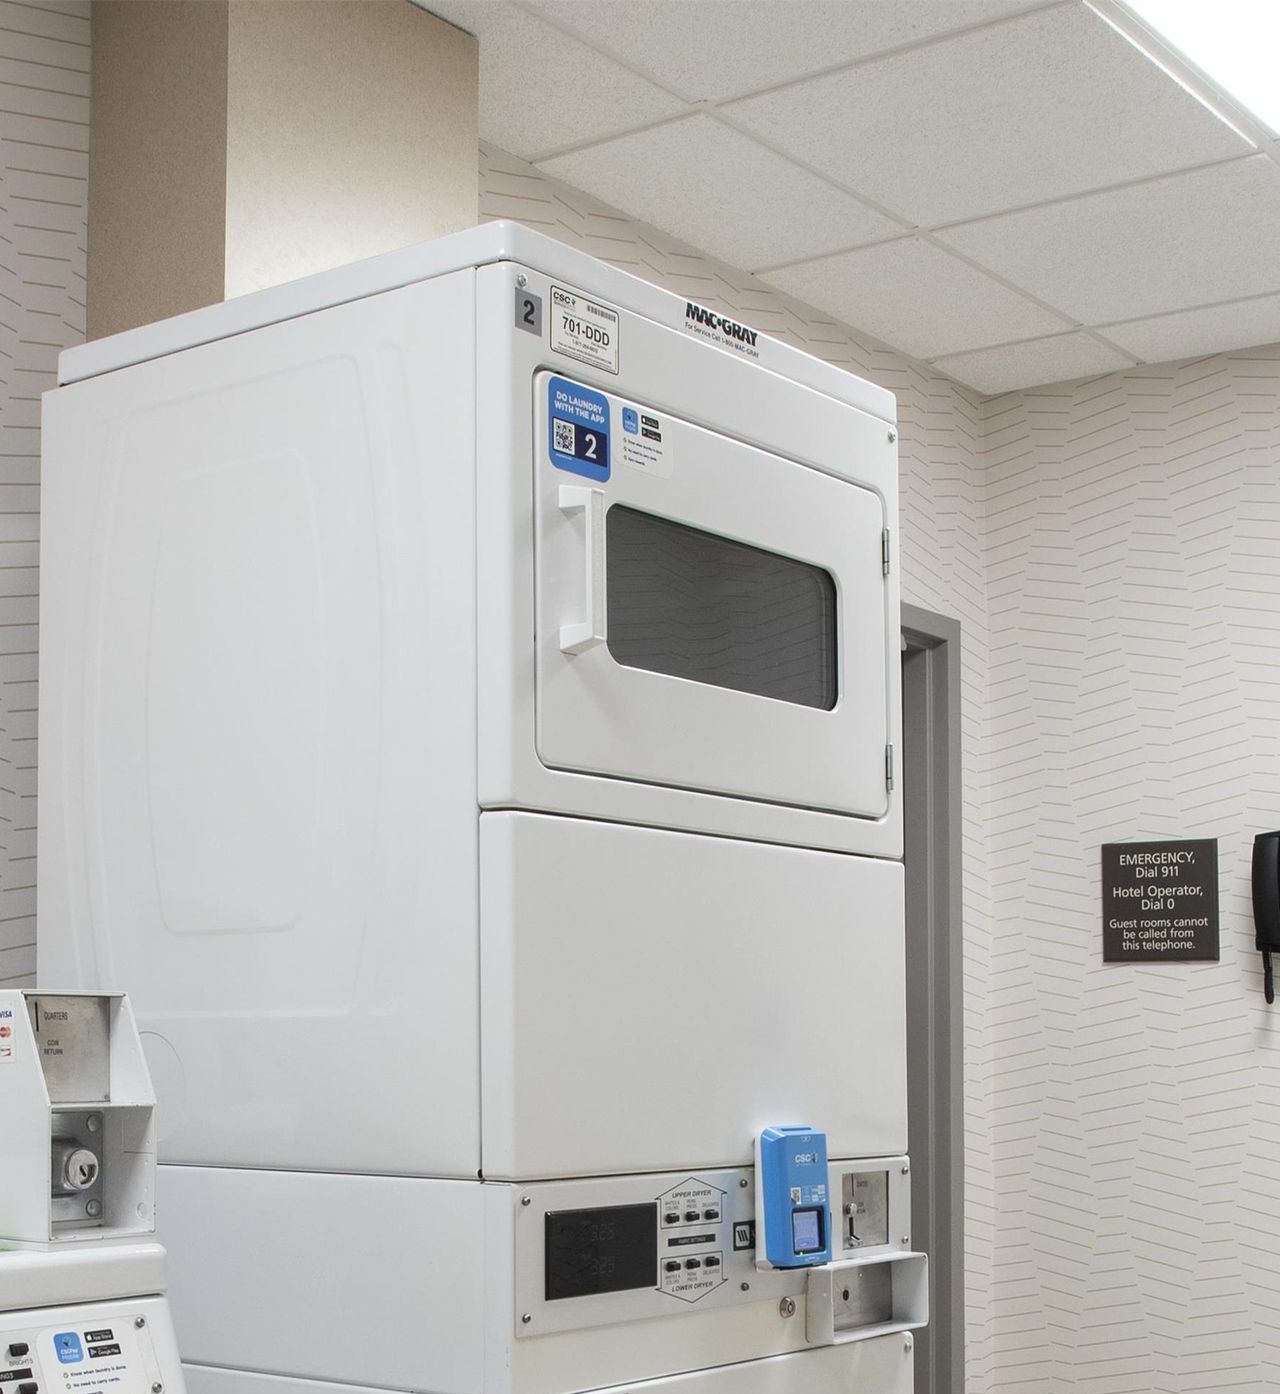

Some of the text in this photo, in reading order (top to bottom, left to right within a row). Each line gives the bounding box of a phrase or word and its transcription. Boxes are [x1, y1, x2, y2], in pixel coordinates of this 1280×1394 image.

[553, 291, 571, 305] CSC
[523, 299, 535, 326] 2
[562, 316, 610, 346] 701-DDD
[685, 321, 693, 330] For
[694, 325, 711, 339] Service
[556, 391, 603, 414] DO LAUNDRY
[554, 400, 605, 425] WITH THE APP
[585, 433, 597, 459] 2
[1119, 851, 1195, 866] EMERGENCY,
[1135, 865, 1179, 878] Dial 911
[1113, 885, 1204, 899] Hotel Operator,
[1141, 898, 1175, 910] Dial 0
[1109, 917, 1209, 929] Guest rooms cannot
[1123, 927, 1194, 939] be called from
[1122, 939, 1196, 951] this telephone.
[0, 1010, 13, 1019] VISA
[43, 1012, 68, 1021] QUARTERS
[794, 1154, 811, 1163] CSC
[672, 1189, 712, 1199] UPPER DRYER
[671, 1281, 714, 1292] LOWER DRYER
[9, 1358, 34, 1367] BRIGHTS
